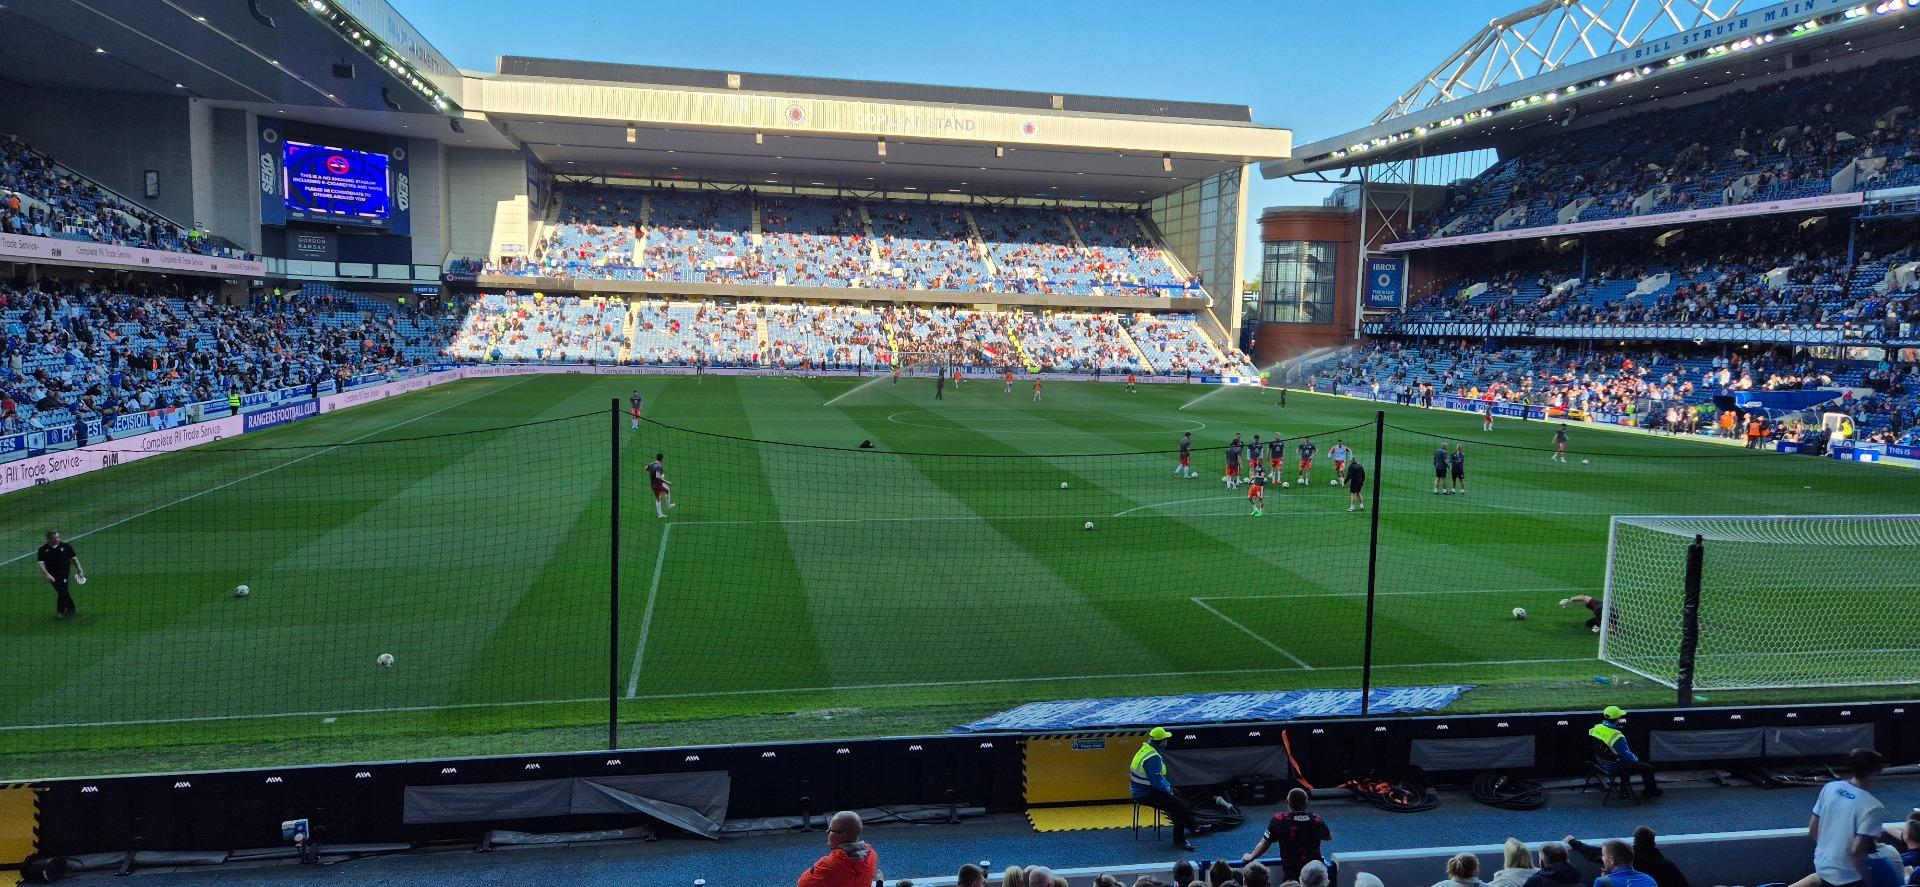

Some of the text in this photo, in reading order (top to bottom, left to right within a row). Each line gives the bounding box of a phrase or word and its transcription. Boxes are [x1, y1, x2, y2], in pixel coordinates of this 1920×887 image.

[1635, 0, 1815, 59] BILL STRUTH MAIN
[928, 117, 976, 131] STAND
[261, 152, 275, 195] SEKO
[331, 189, 364, 197] CONSIDERATE
[398, 172, 409, 211] SEKO
[2, 238, 17, 249] Trade
[1373, 263, 1396, 271] IBROX
[248, 402, 317, 429] RANGERS FOOTBALL CLUB
[62, 421, 103, 442] FOEST
[183, 427, 199, 442] Trade
[1888, 446, 1903, 455] THIS
[103, 453, 119, 469] AIM
[6, 466, 18, 483] All
[20, 463, 46, 479] Trade
